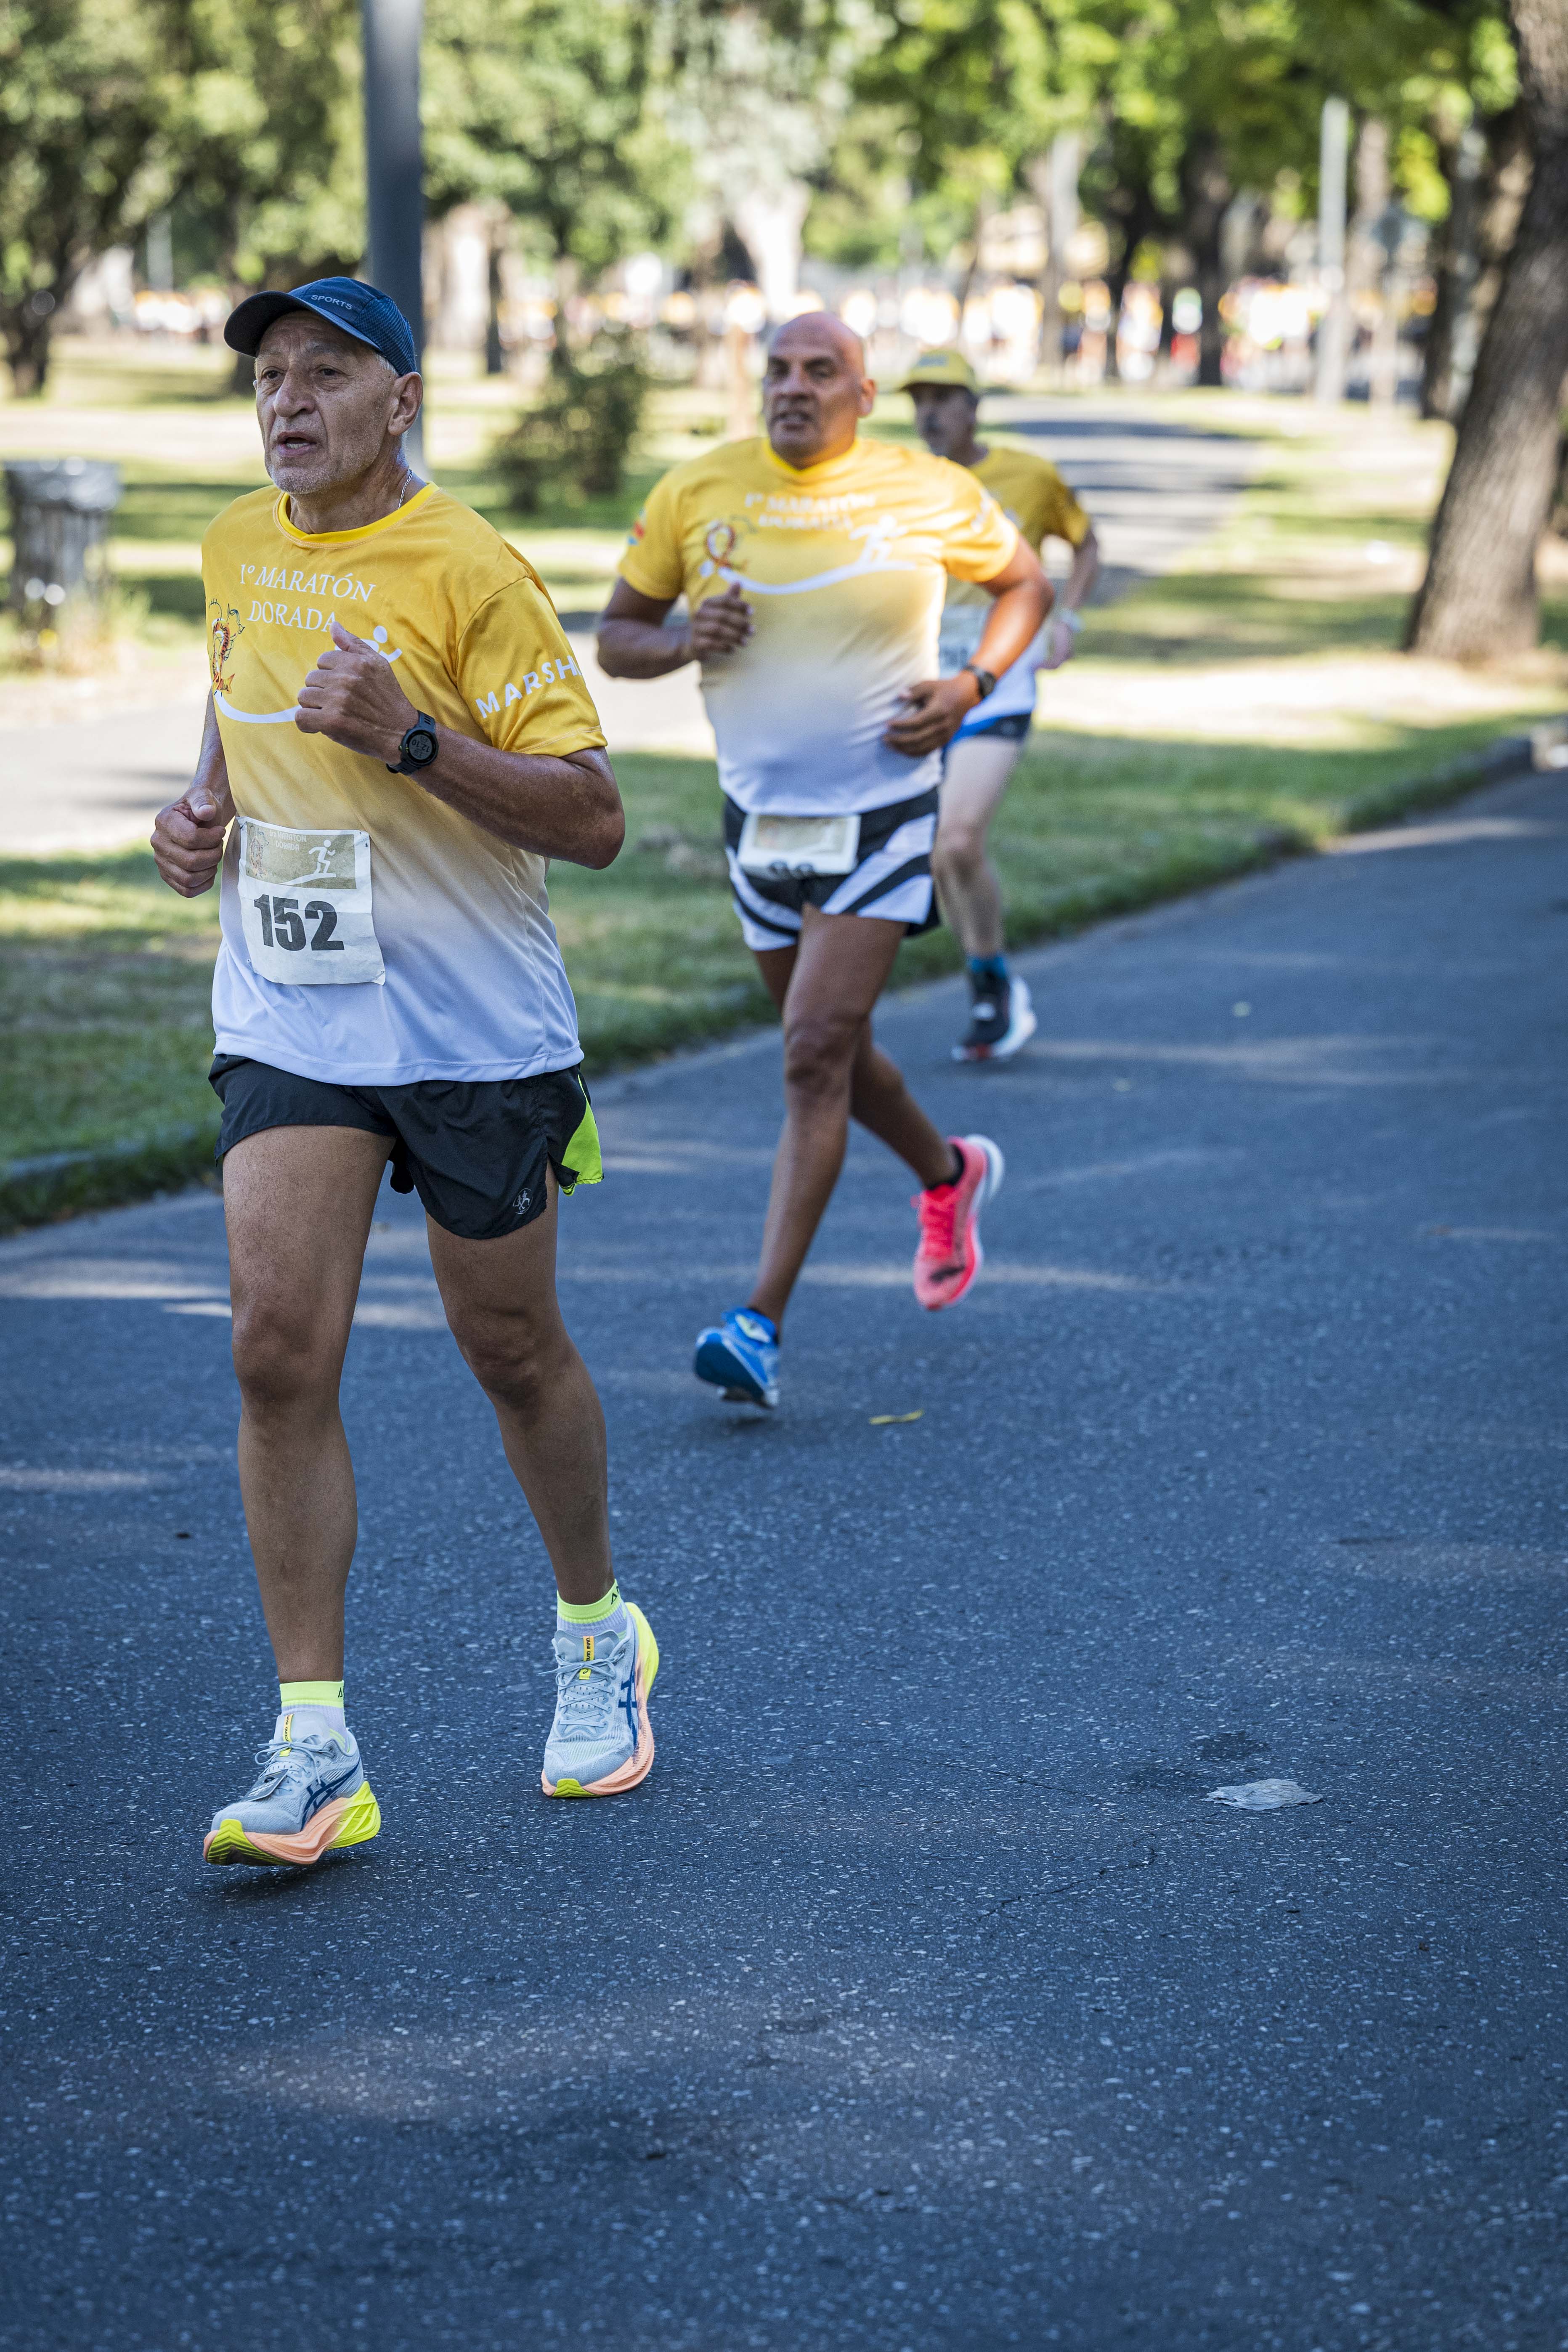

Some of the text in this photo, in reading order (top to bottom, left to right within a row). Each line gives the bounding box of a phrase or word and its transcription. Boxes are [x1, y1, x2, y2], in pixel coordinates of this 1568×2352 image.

[311, 295, 353, 310] SPORTS
[255, 566, 377, 603] MARATÓN
[246, 600, 335, 632] DORADA
[254, 894, 345, 951] 152
